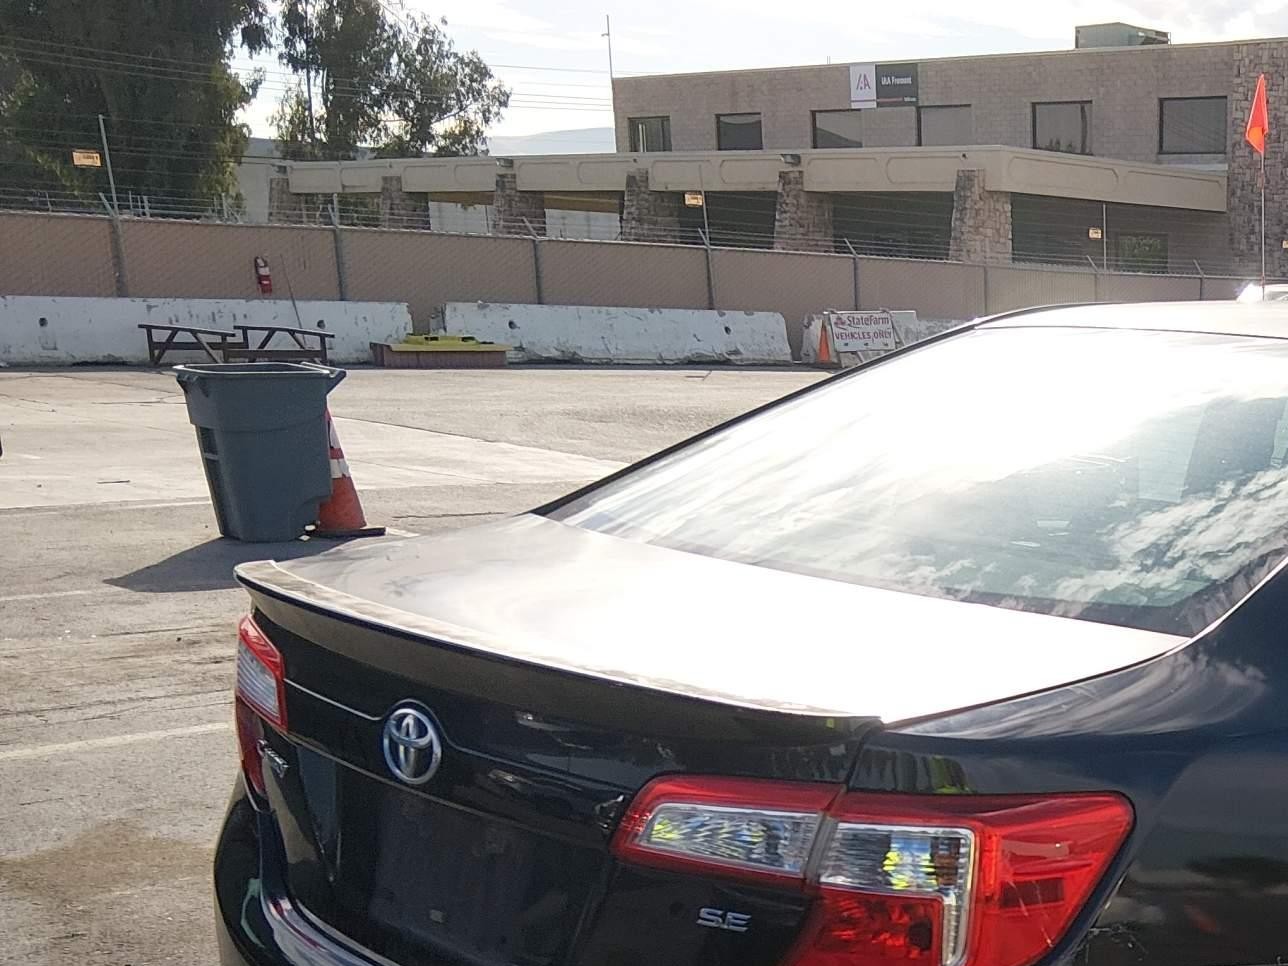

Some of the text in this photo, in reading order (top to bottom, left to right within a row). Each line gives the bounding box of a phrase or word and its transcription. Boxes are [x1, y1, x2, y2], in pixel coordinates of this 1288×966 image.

[835, 330, 892, 340] VEHICLES ONLY
[696, 907, 752, 932] SE
